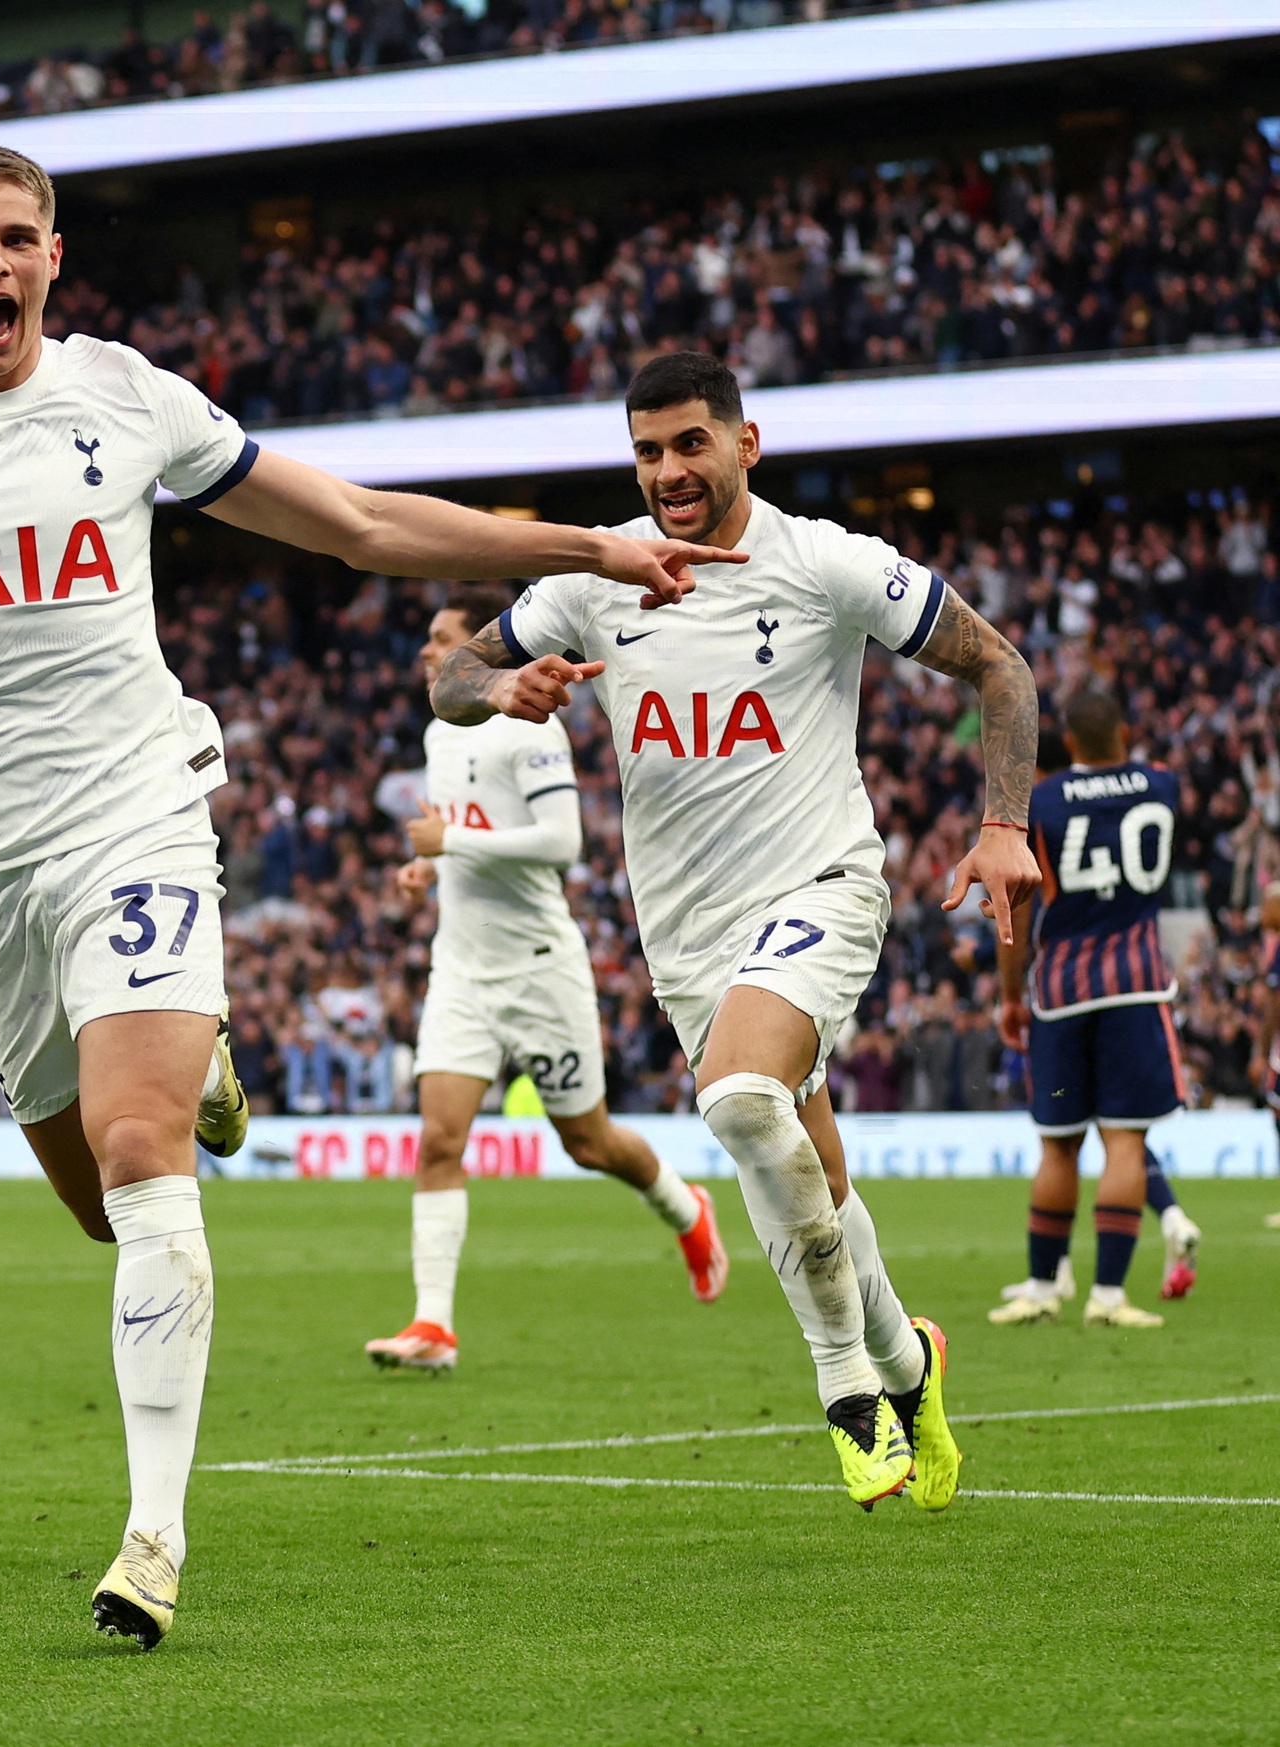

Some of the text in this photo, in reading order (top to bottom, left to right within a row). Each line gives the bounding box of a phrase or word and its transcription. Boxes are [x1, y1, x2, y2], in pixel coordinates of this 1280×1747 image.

[631, 691, 786, 758] AIA
[433, 801, 494, 831] IA
[1059, 801, 1175, 900] 40
[109, 882, 200, 957] 37
[749, 918, 826, 959] 17
[530, 1050, 582, 1091] 22
